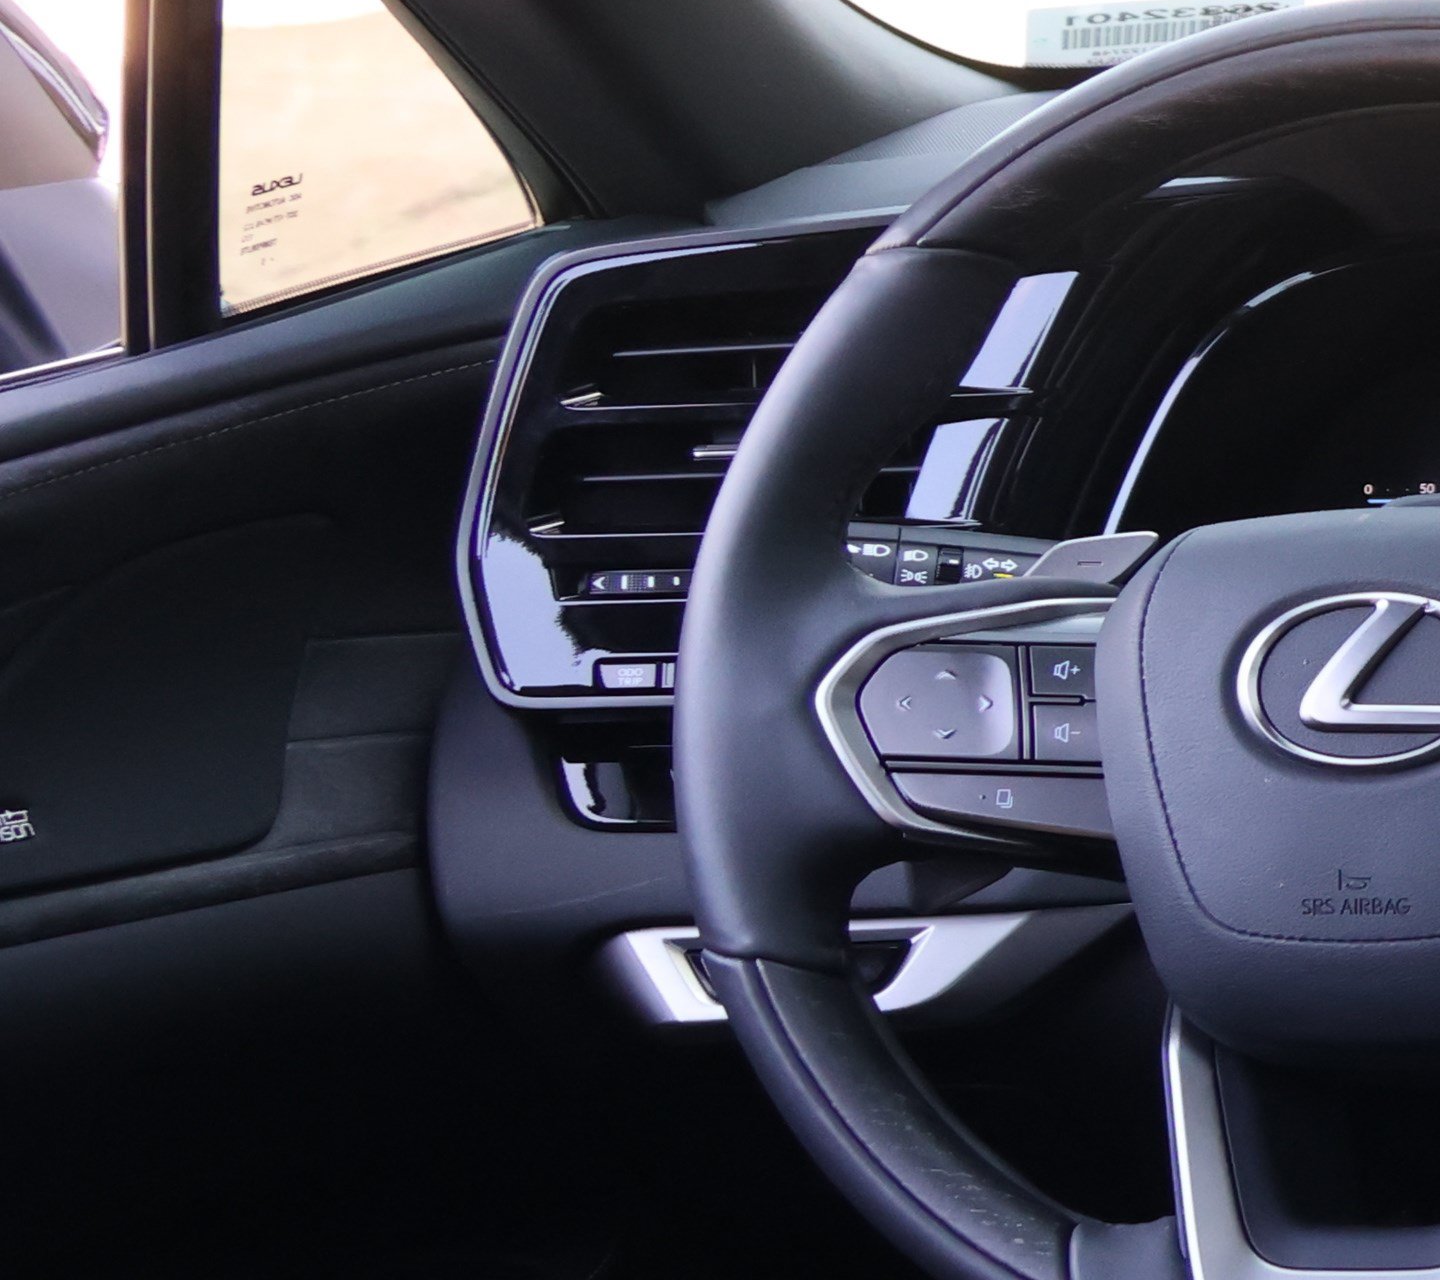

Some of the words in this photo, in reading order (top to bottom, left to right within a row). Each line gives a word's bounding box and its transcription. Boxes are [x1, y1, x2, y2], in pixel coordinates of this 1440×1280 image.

[1363, 484, 1374, 495] 0
[1419, 483, 1436, 494] 50
[617, 667, 644, 677] ODO
[617, 677, 644, 686] TRIP
[1301, 898, 1335, 915] SRS
[1340, 898, 1411, 915] AIRBAG
